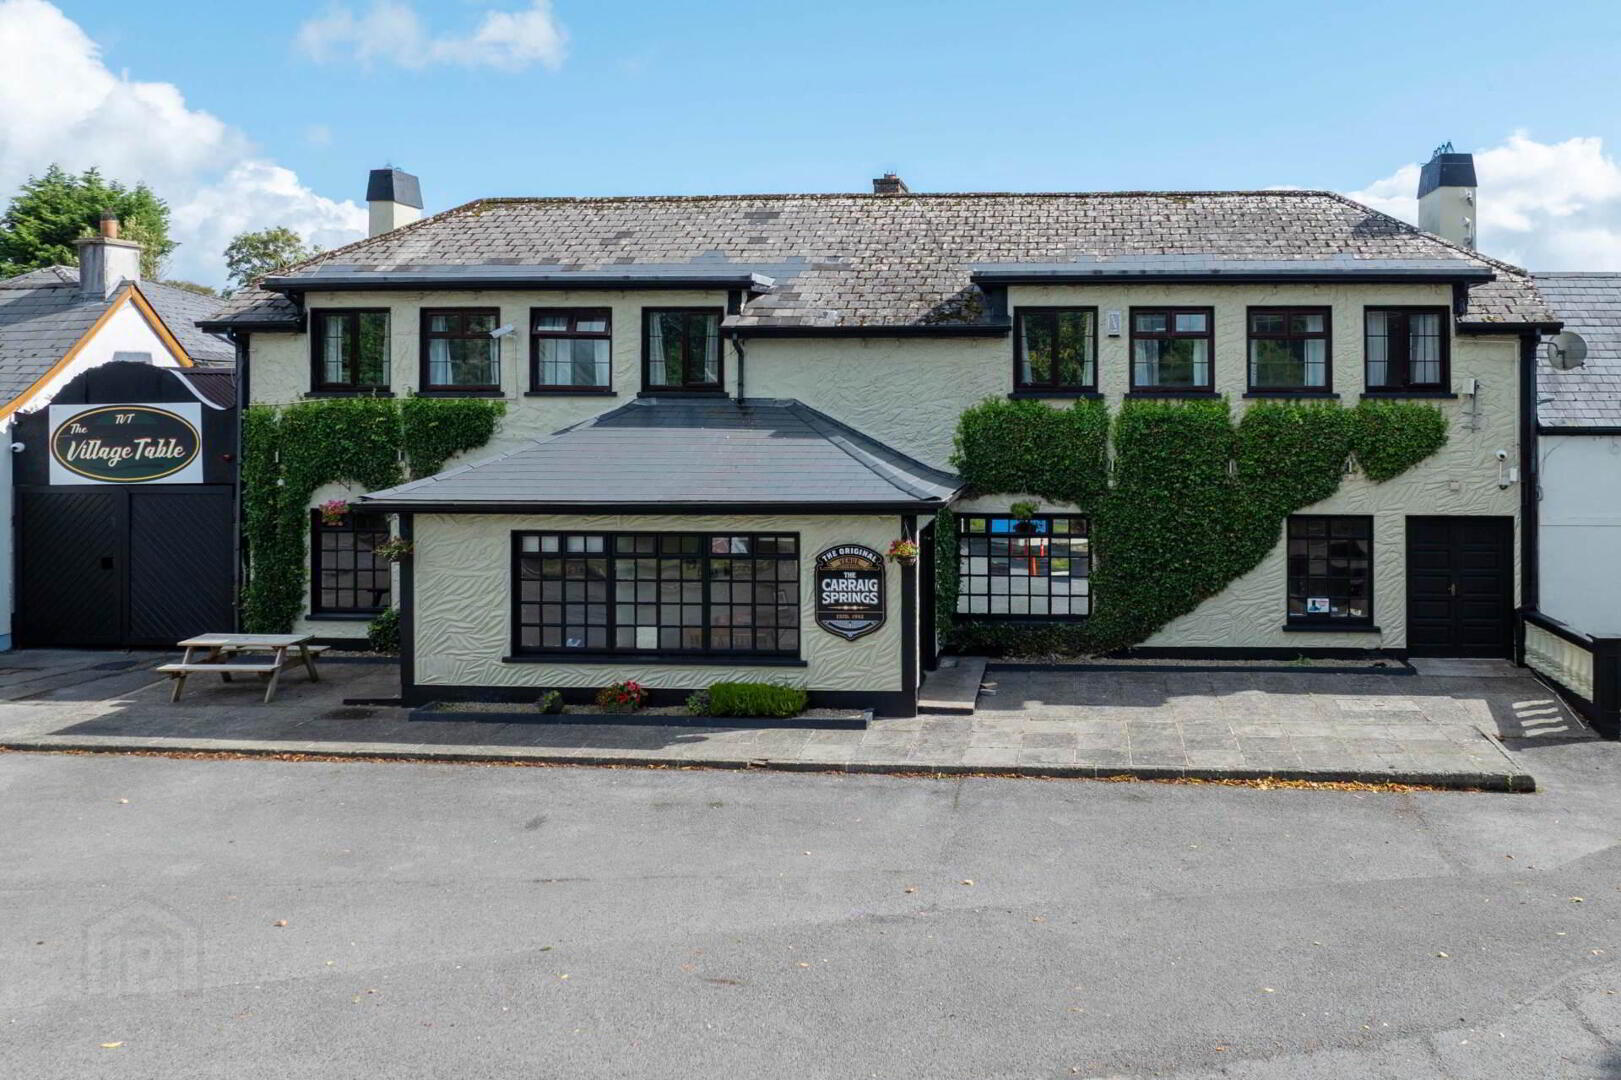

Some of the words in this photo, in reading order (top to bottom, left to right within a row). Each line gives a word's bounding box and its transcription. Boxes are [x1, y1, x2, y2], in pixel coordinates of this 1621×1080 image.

[70, 423, 88, 435] The
[66, 439, 133, 467] Village
[133, 437, 186, 460] Table
[822, 549, 839, 562] THE
[838, 547, 877, 562] ORIGINAL
[843, 571, 857, 579] THE
[821, 578, 879, 592] CARRAIG
[821, 591, 879, 605] SPRINGS
